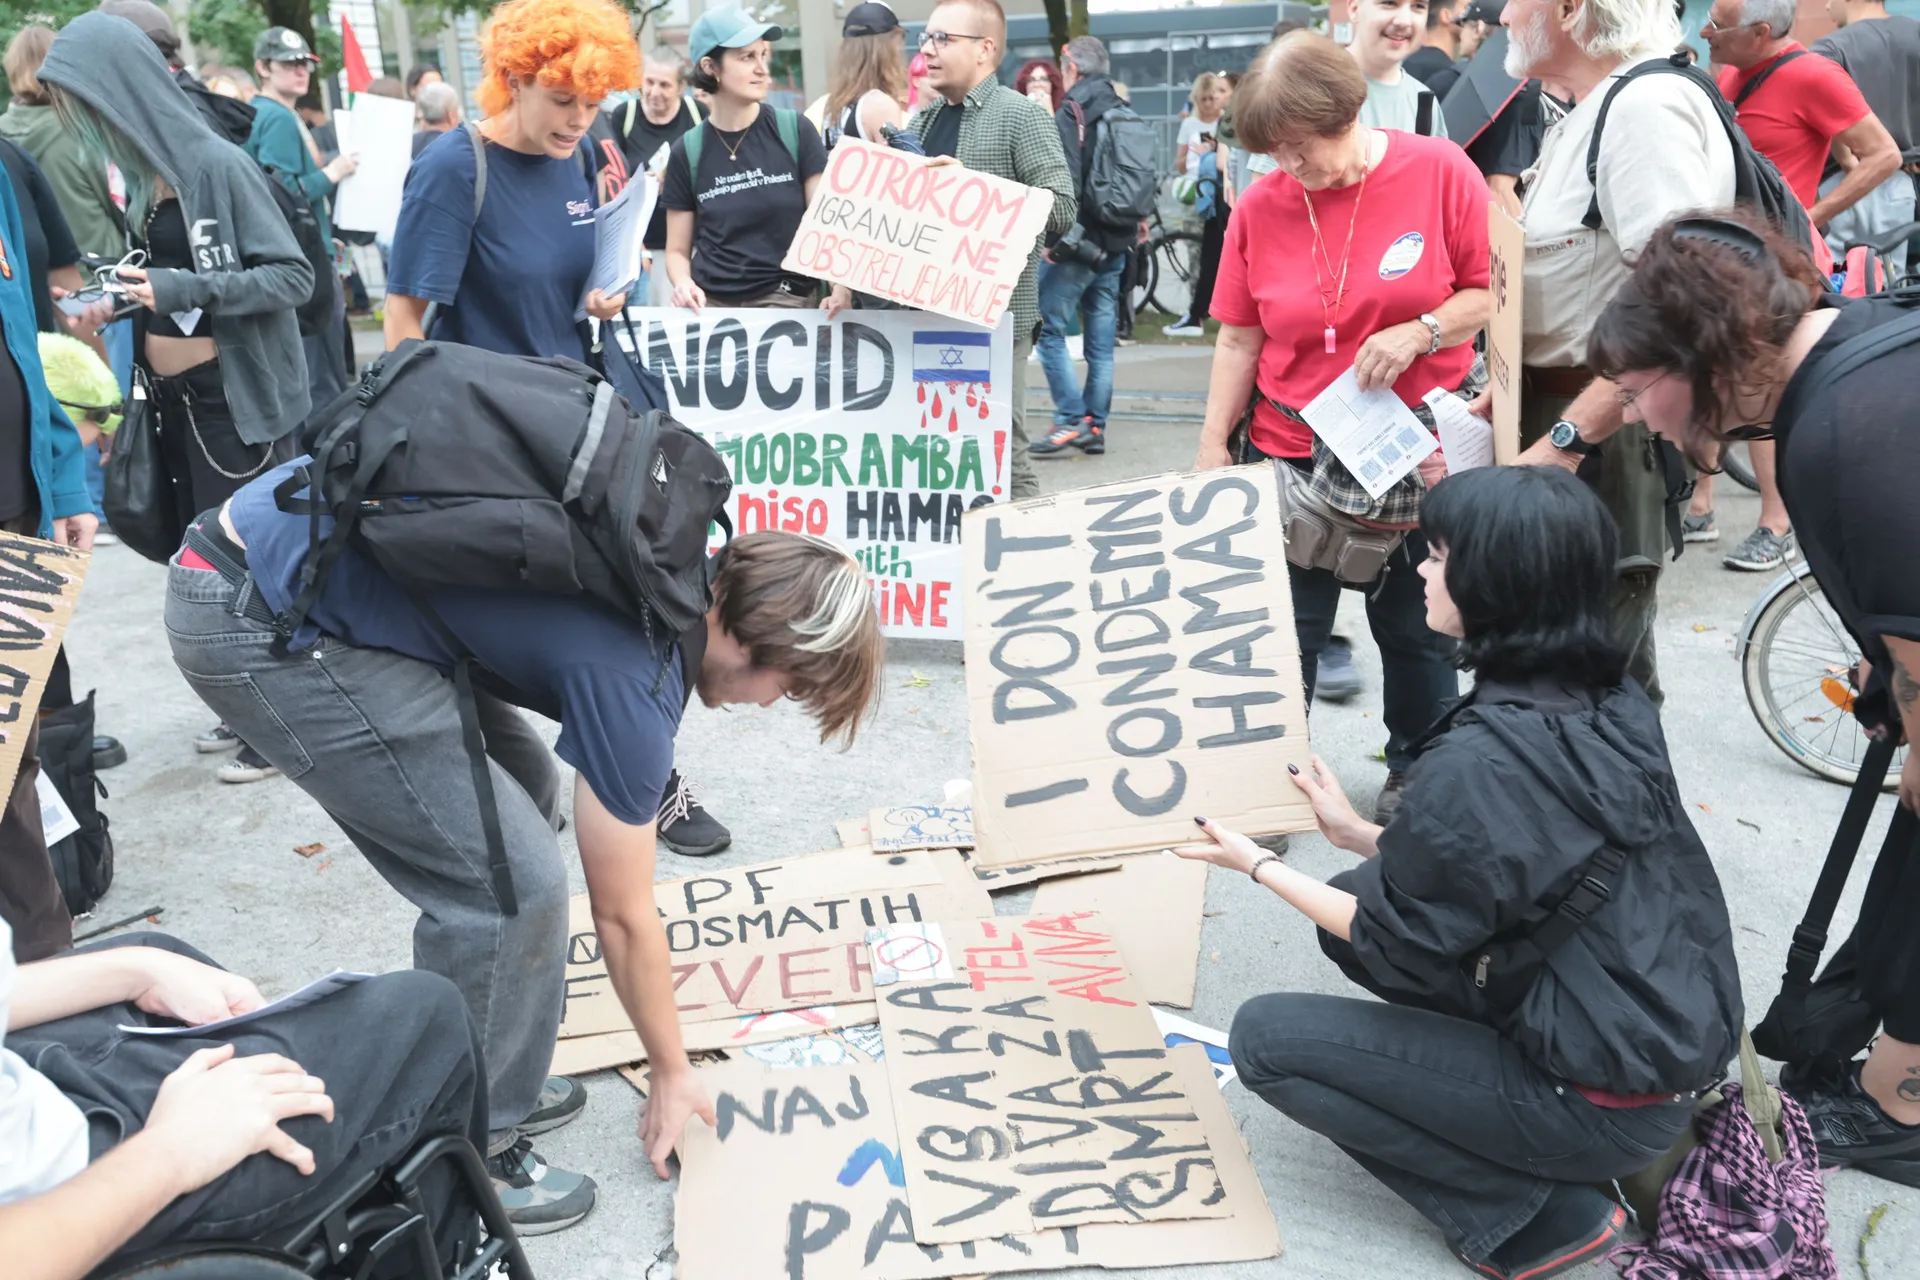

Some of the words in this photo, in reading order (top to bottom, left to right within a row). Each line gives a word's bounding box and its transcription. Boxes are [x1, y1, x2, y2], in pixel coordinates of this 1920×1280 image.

[730, 178, 758, 194] genocid
[829, 146, 1026, 239] OTROKOM
[813, 193, 944, 254] IGRANJE
[952, 235, 1007, 275] NE
[798, 230, 1013, 323] OBSTRELJEVANJE
[714, 430, 1006, 496] MOOBRAMBA!
[738, 489, 828, 536] niso
[846, 490, 994, 544] HAMA
[867, 579, 951, 627] iNE
[977, 517, 1082, 724] DON'T
[1168, 476, 1287, 749] HAMAS
[1084, 488, 1188, 817] CONDEMN
[1005, 777, 1090, 808] I
[666, 893, 923, 952] OSMATIH
[963, 921, 1035, 992] TEL-
[1023, 911, 1138, 1007] AVIVA
[981, 996, 1063, 1057] ZA
[716, 1074, 870, 1143] NAJ
[886, 982, 1021, 1227] VSAKA
[1068, 1028, 1227, 1221] SMRT
